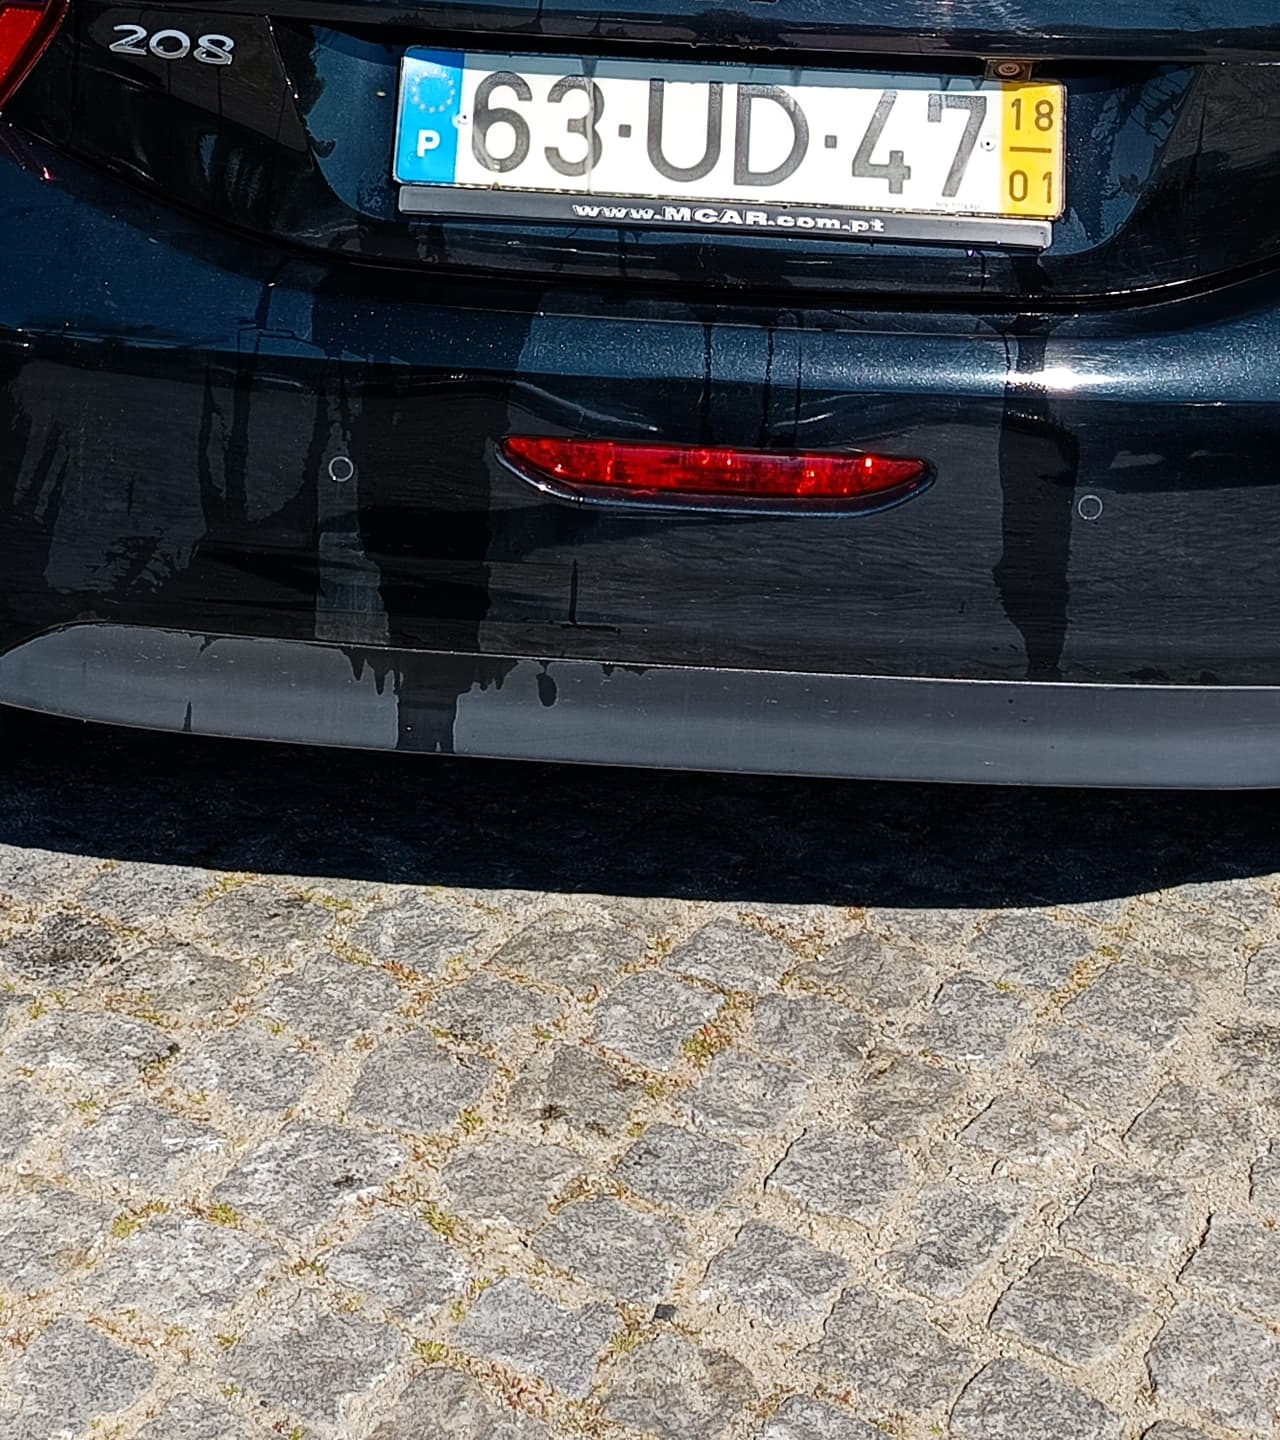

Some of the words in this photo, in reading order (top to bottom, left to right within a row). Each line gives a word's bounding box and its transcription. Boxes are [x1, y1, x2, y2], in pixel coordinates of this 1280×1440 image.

[109, 24, 235, 65] 208
[1011, 98, 1054, 132] 18
[416, 129, 440, 158] P
[1009, 169, 1053, 205] 01
[572, 204, 885, 234] www.MCAR.com.pt
